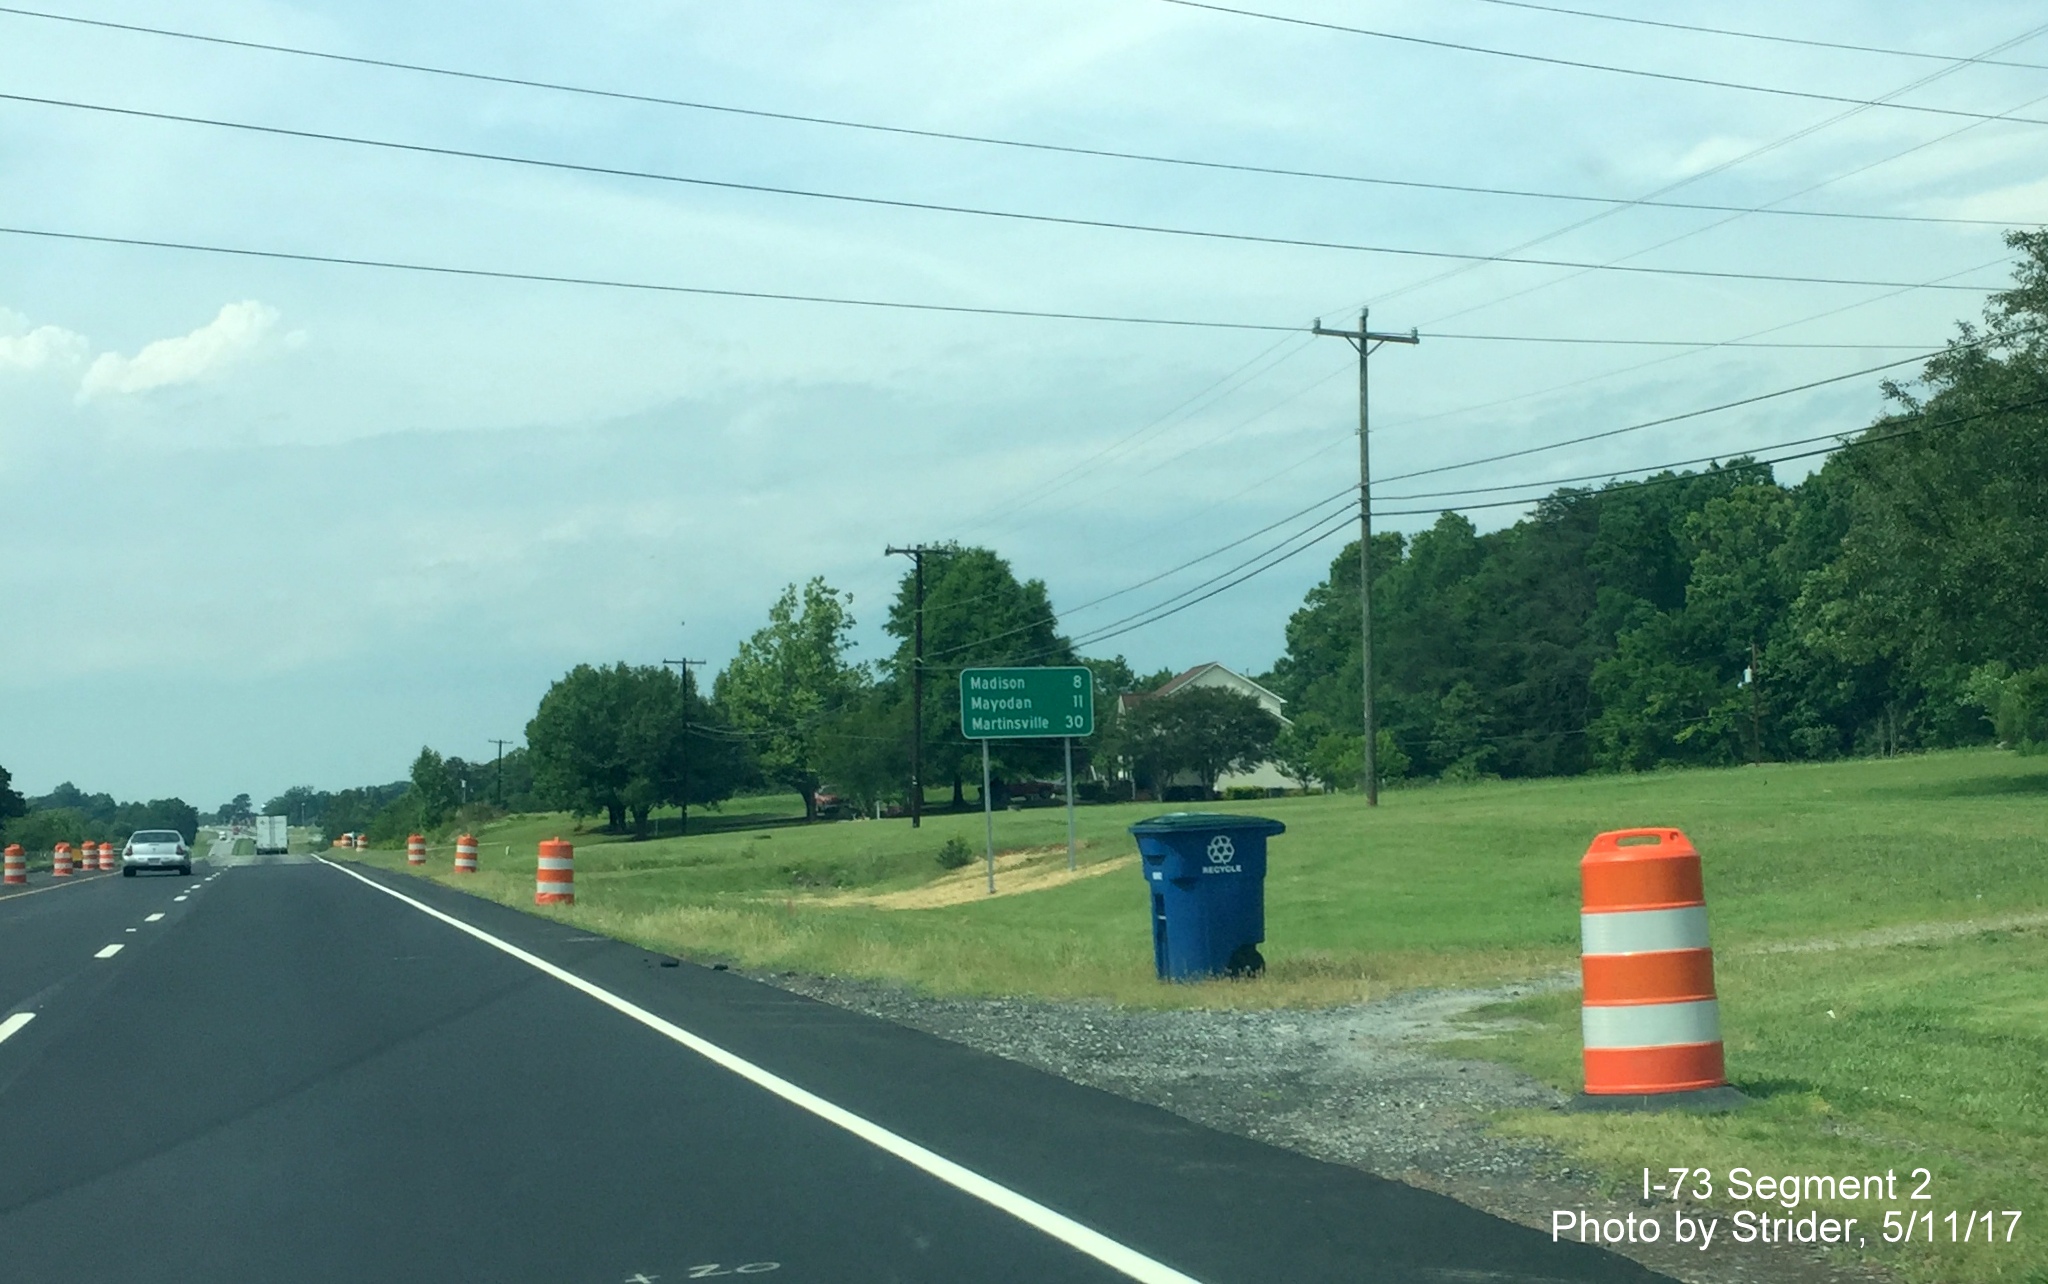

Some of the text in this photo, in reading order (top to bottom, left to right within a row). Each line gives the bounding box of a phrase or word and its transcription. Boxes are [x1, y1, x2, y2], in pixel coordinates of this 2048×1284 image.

[970, 675, 1082, 690] Madison 8
[971, 695, 1083, 712] Mayodan 11
[972, 715, 1084, 730] Martinsville 30
[1202, 864, 1242, 874] RECYCLE
